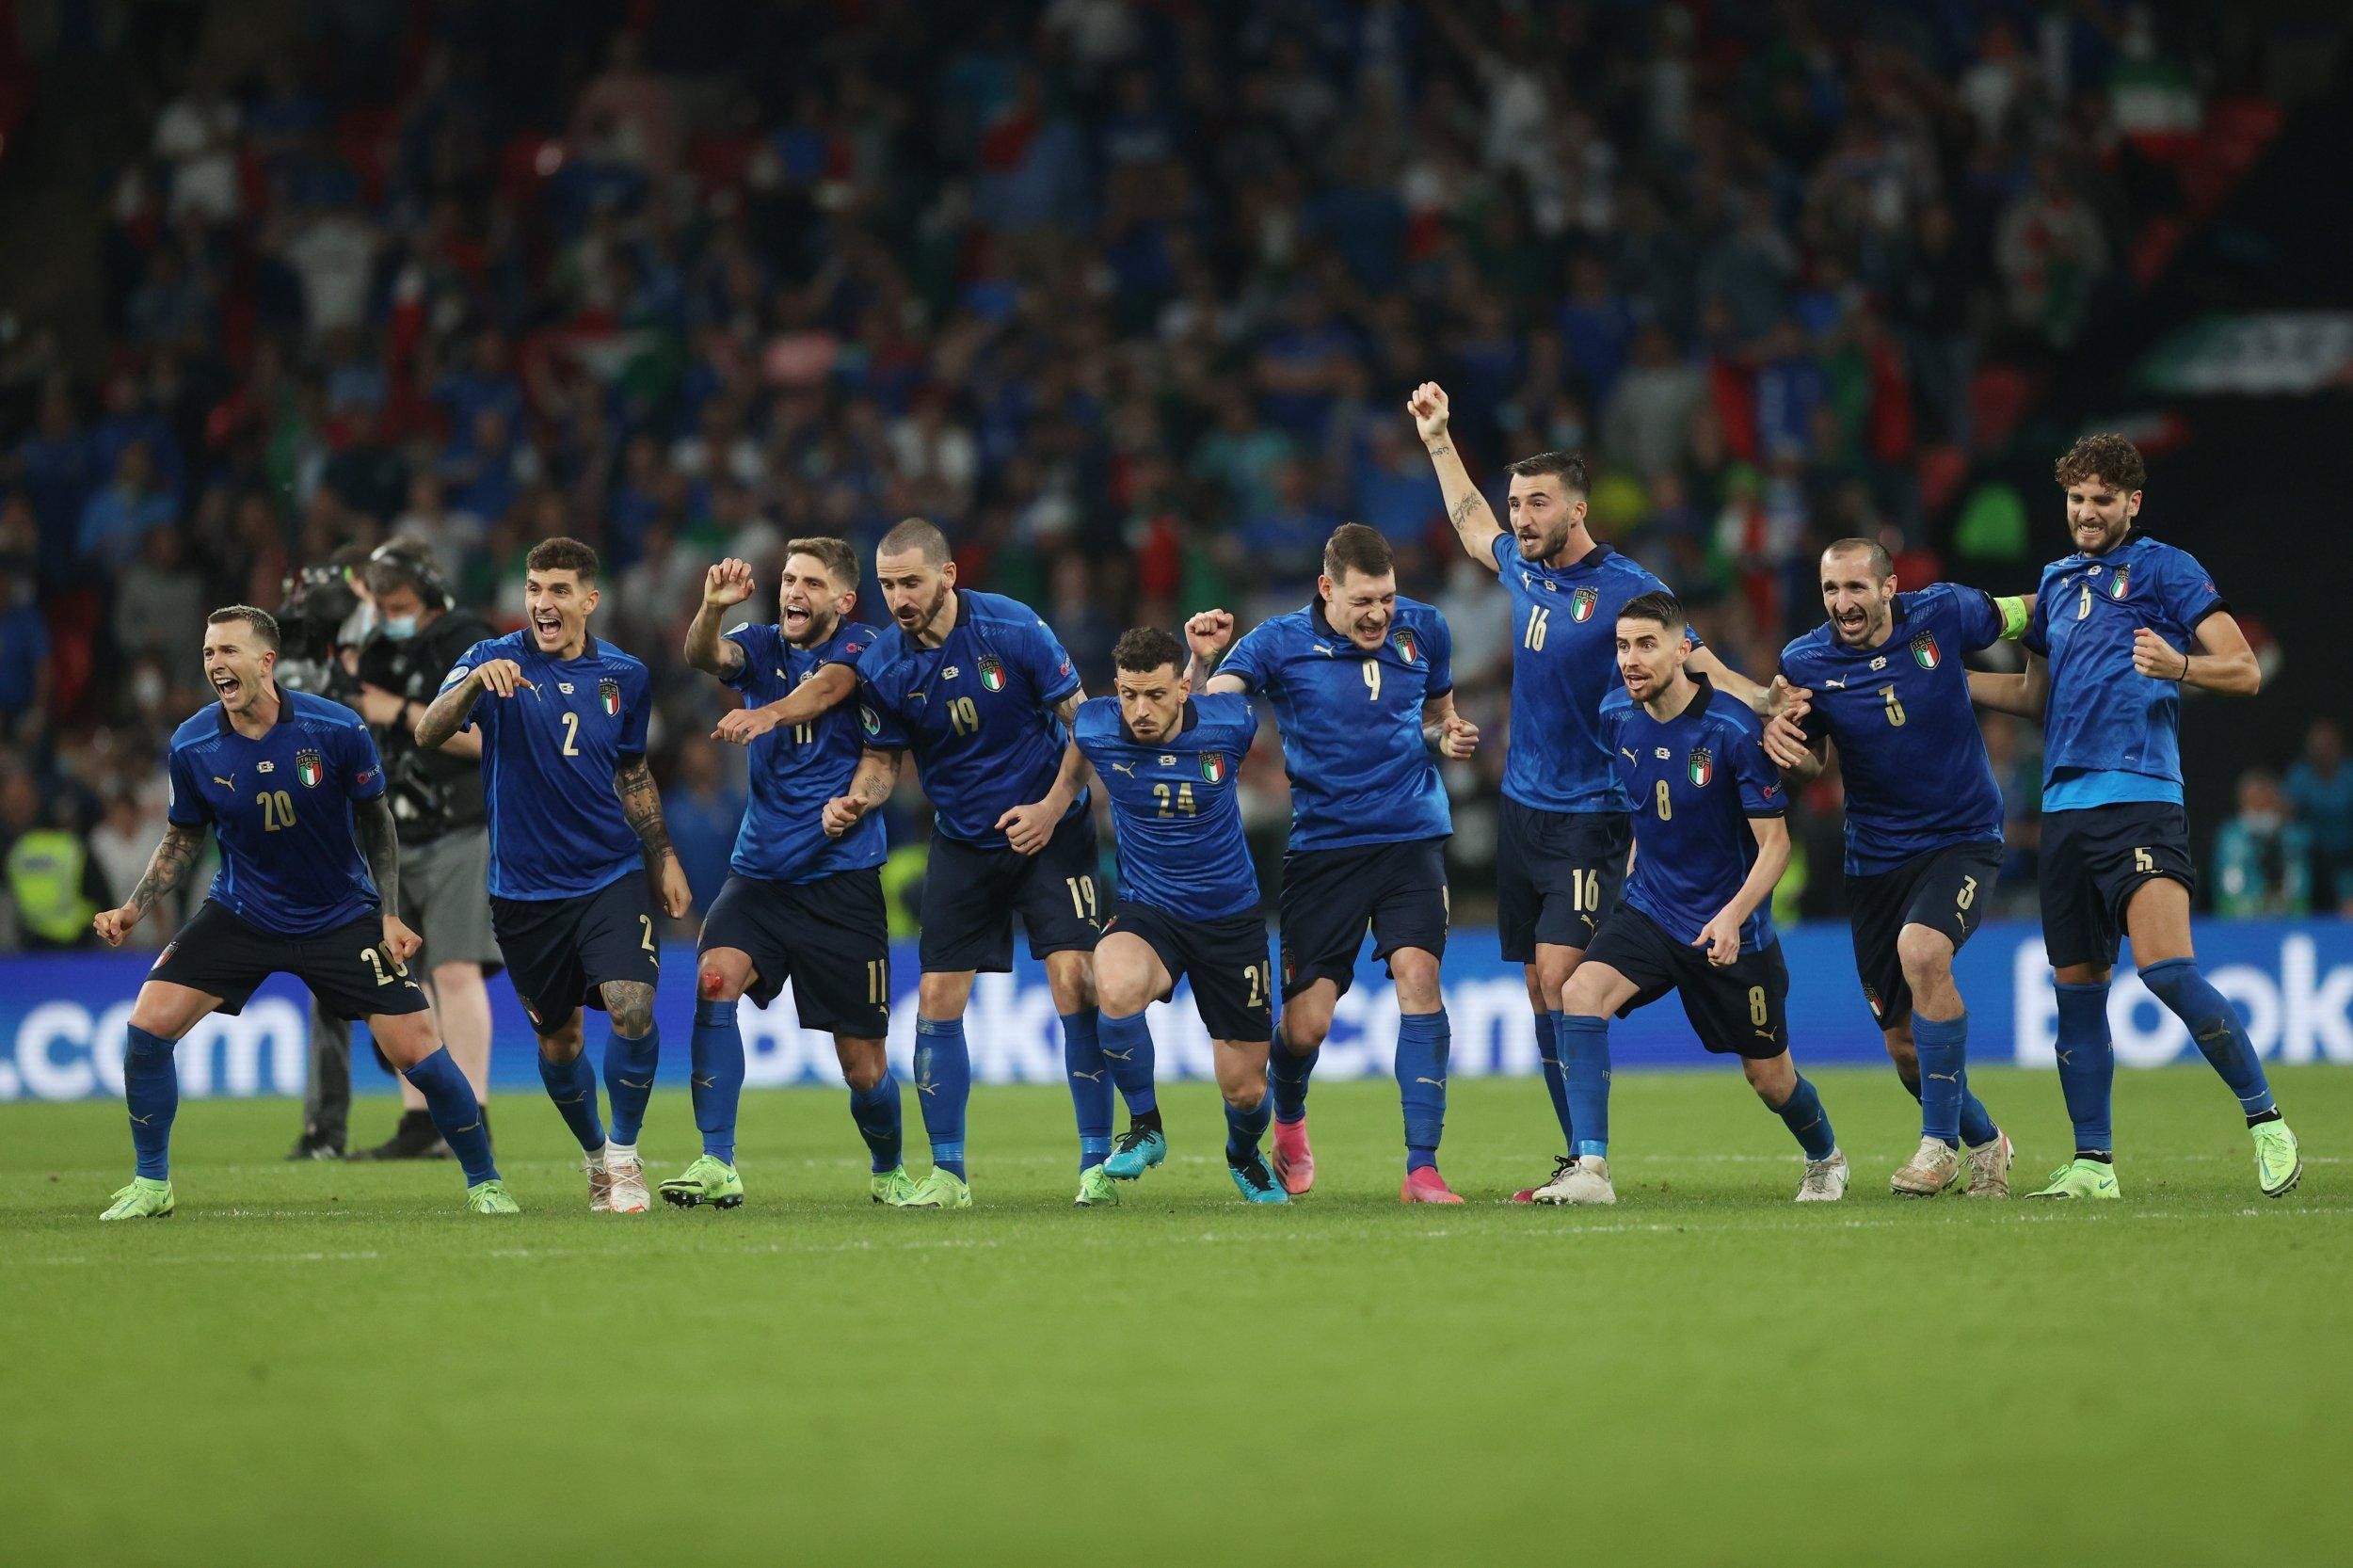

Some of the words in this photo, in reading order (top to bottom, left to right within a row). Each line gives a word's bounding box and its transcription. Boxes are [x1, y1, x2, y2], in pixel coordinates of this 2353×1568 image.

[1524, 604, 1551, 651] 16
[1362, 658, 1381, 701] 9
[946, 696, 979, 737] 19
[1878, 684, 1907, 727] 3
[562, 712, 579, 756] 2
[256, 790, 297, 832] 20
[1153, 782, 1196, 819] 24
[1656, 779, 1673, 822] 8
[2135, 846, 2153, 873] 5
[1065, 874, 1096, 920] 19
[1573, 869, 1599, 912] 16
[1956, 874, 1977, 910] 3
[639, 914, 656, 952] 2
[360, 940, 408, 987] 20
[867, 958, 887, 1004] 11
[1748, 985, 1768, 1027] 8
